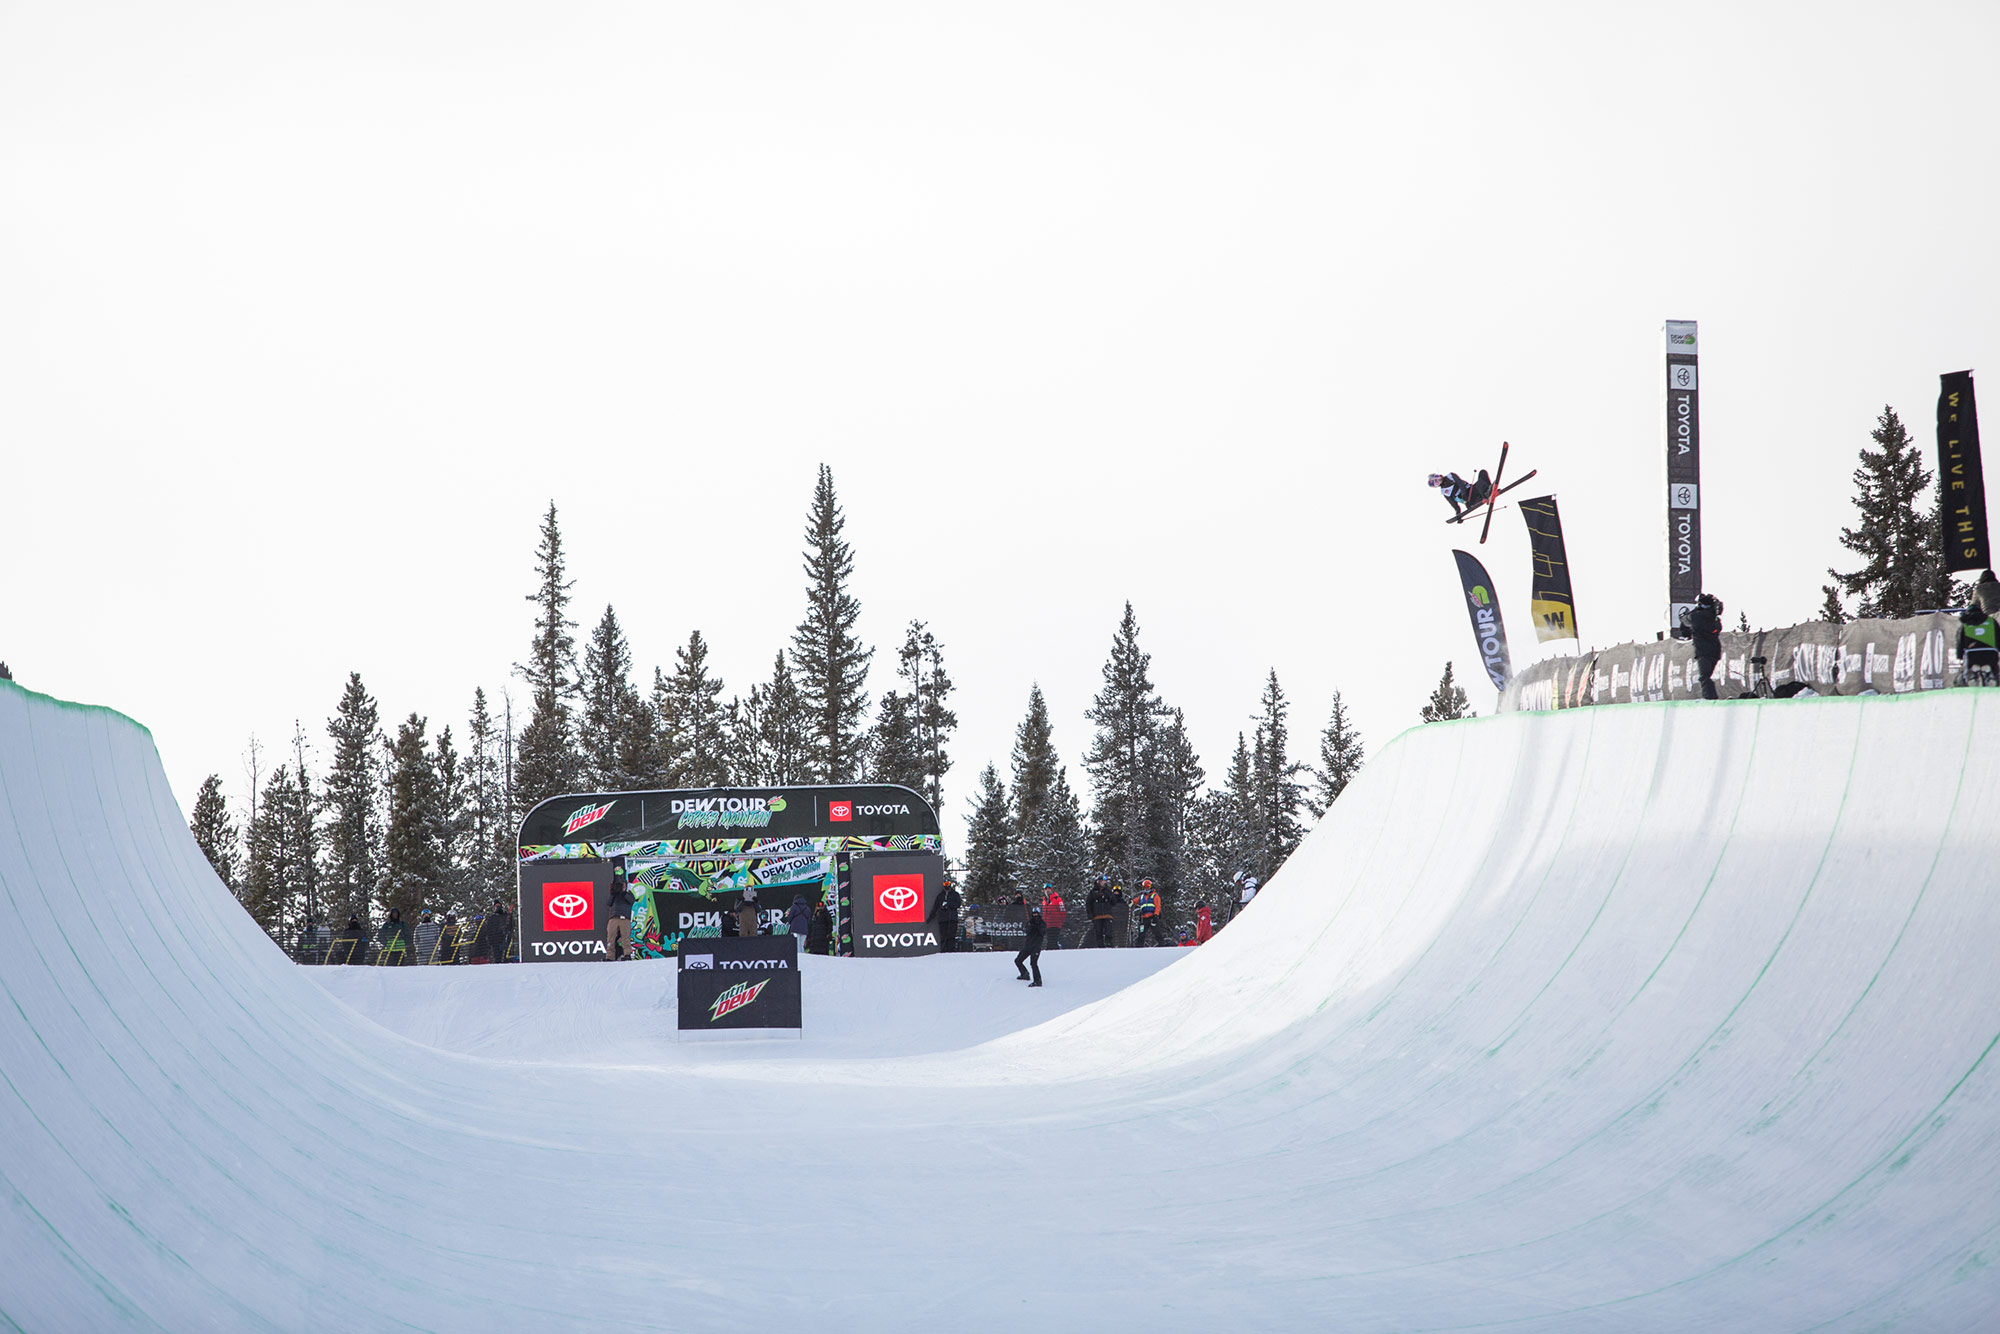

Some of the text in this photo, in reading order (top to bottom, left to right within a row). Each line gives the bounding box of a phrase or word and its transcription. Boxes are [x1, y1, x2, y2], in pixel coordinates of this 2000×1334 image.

[1677, 395, 1691, 455] TOYOTA
[1949, 439, 1965, 491] LIVE
[1955, 505, 1978, 559] THIS
[1678, 513, 1691, 575] TOYOTA
[1476, 607, 1503, 674] TOUR
[671, 797, 767, 814] DEW TOUR
[856, 804, 911, 816] TOYOTA
[677, 808, 773, 830] COPPER MOUNTAIN
[780, 837, 811, 852] TOUR
[761, 856, 816, 879] DEW TOUR
[530, 940, 608, 956] TOYOTA
[862, 932, 938, 949] TOYOTA
[719, 959, 789, 969] TOYOTA
